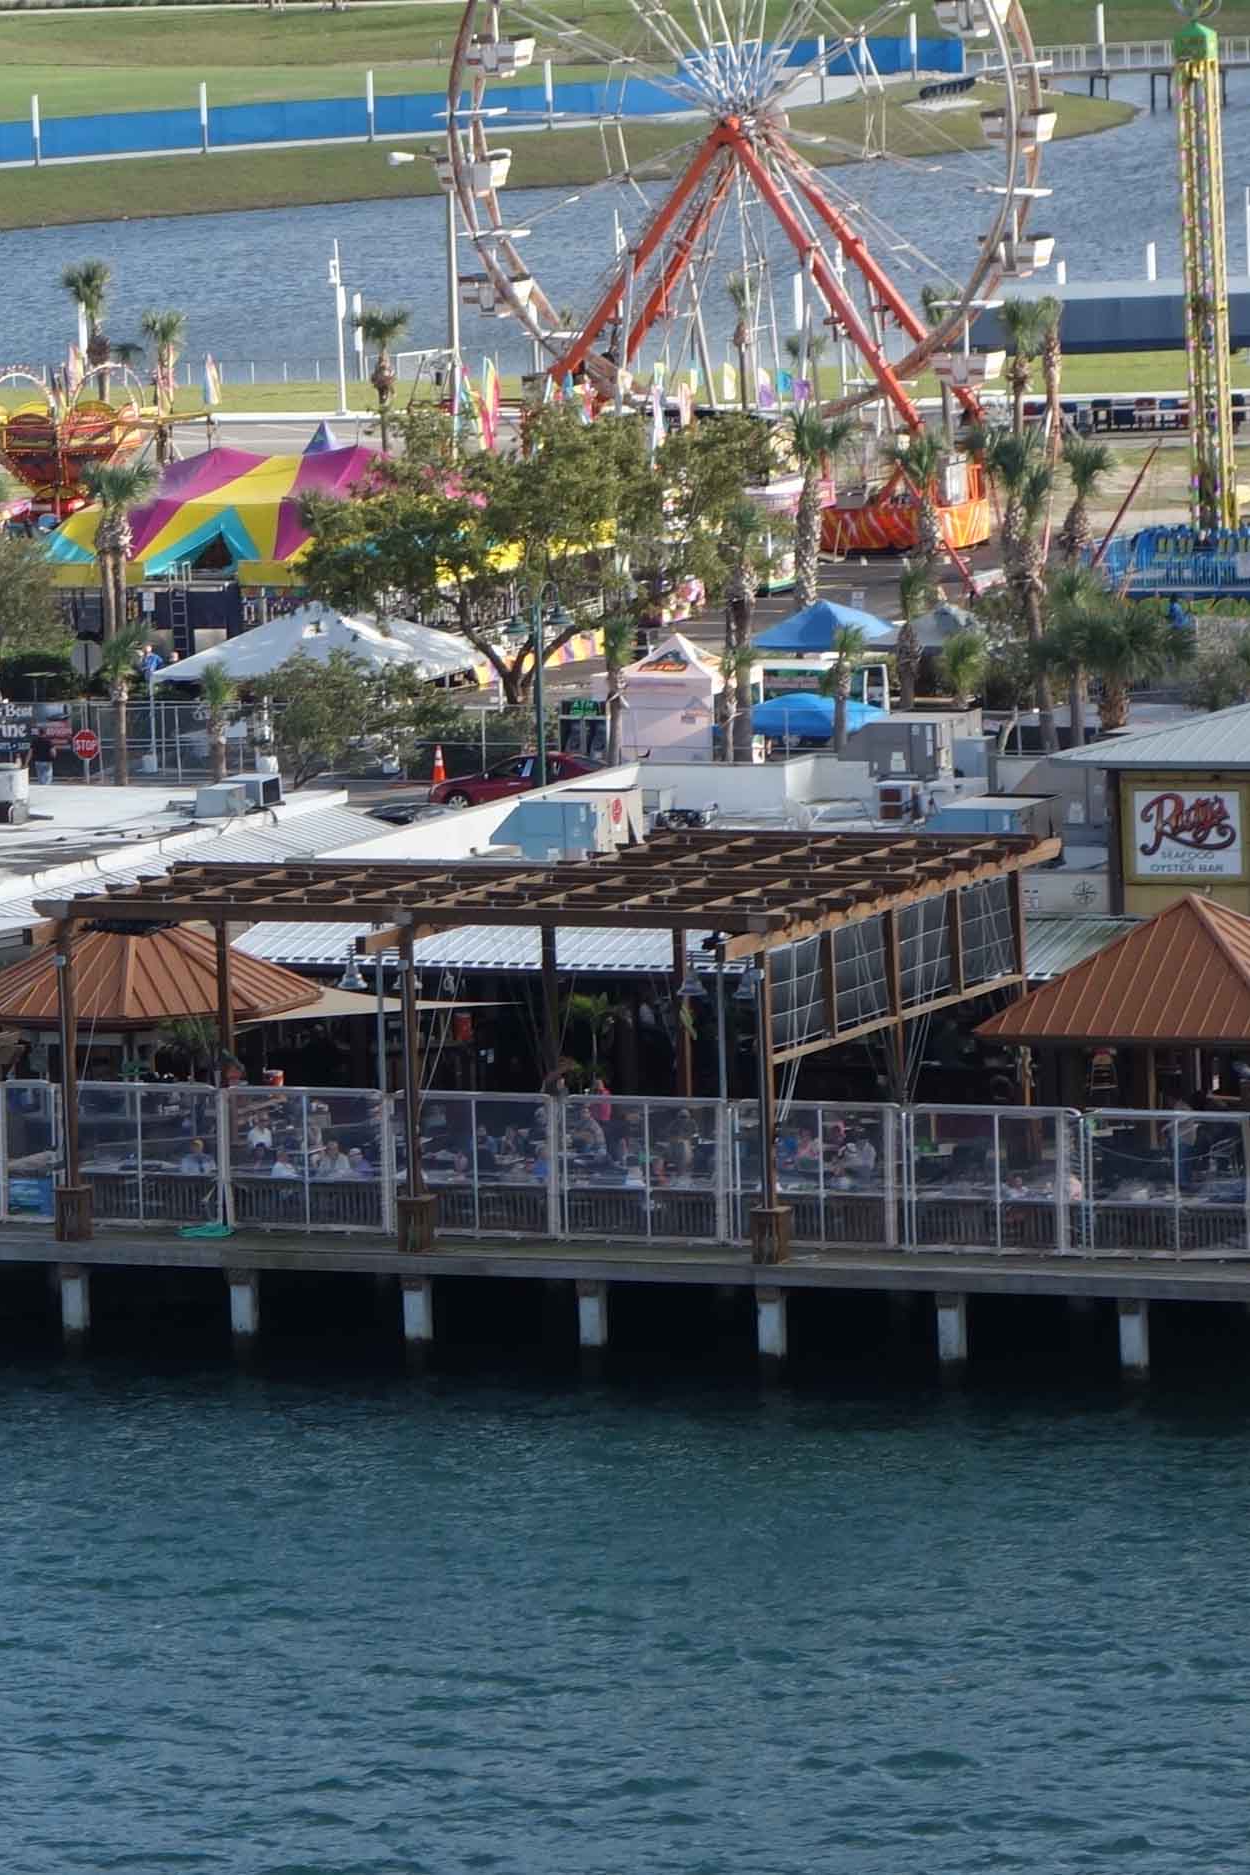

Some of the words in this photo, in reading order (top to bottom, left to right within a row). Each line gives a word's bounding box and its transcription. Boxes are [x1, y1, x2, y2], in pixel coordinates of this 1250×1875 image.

[76, 740, 96, 751] STOP
[1161, 851, 1215, 860] SEAFOOD
[1150, 863, 1195, 872] OYSTER
[1198, 863, 1224, 872] BAR
